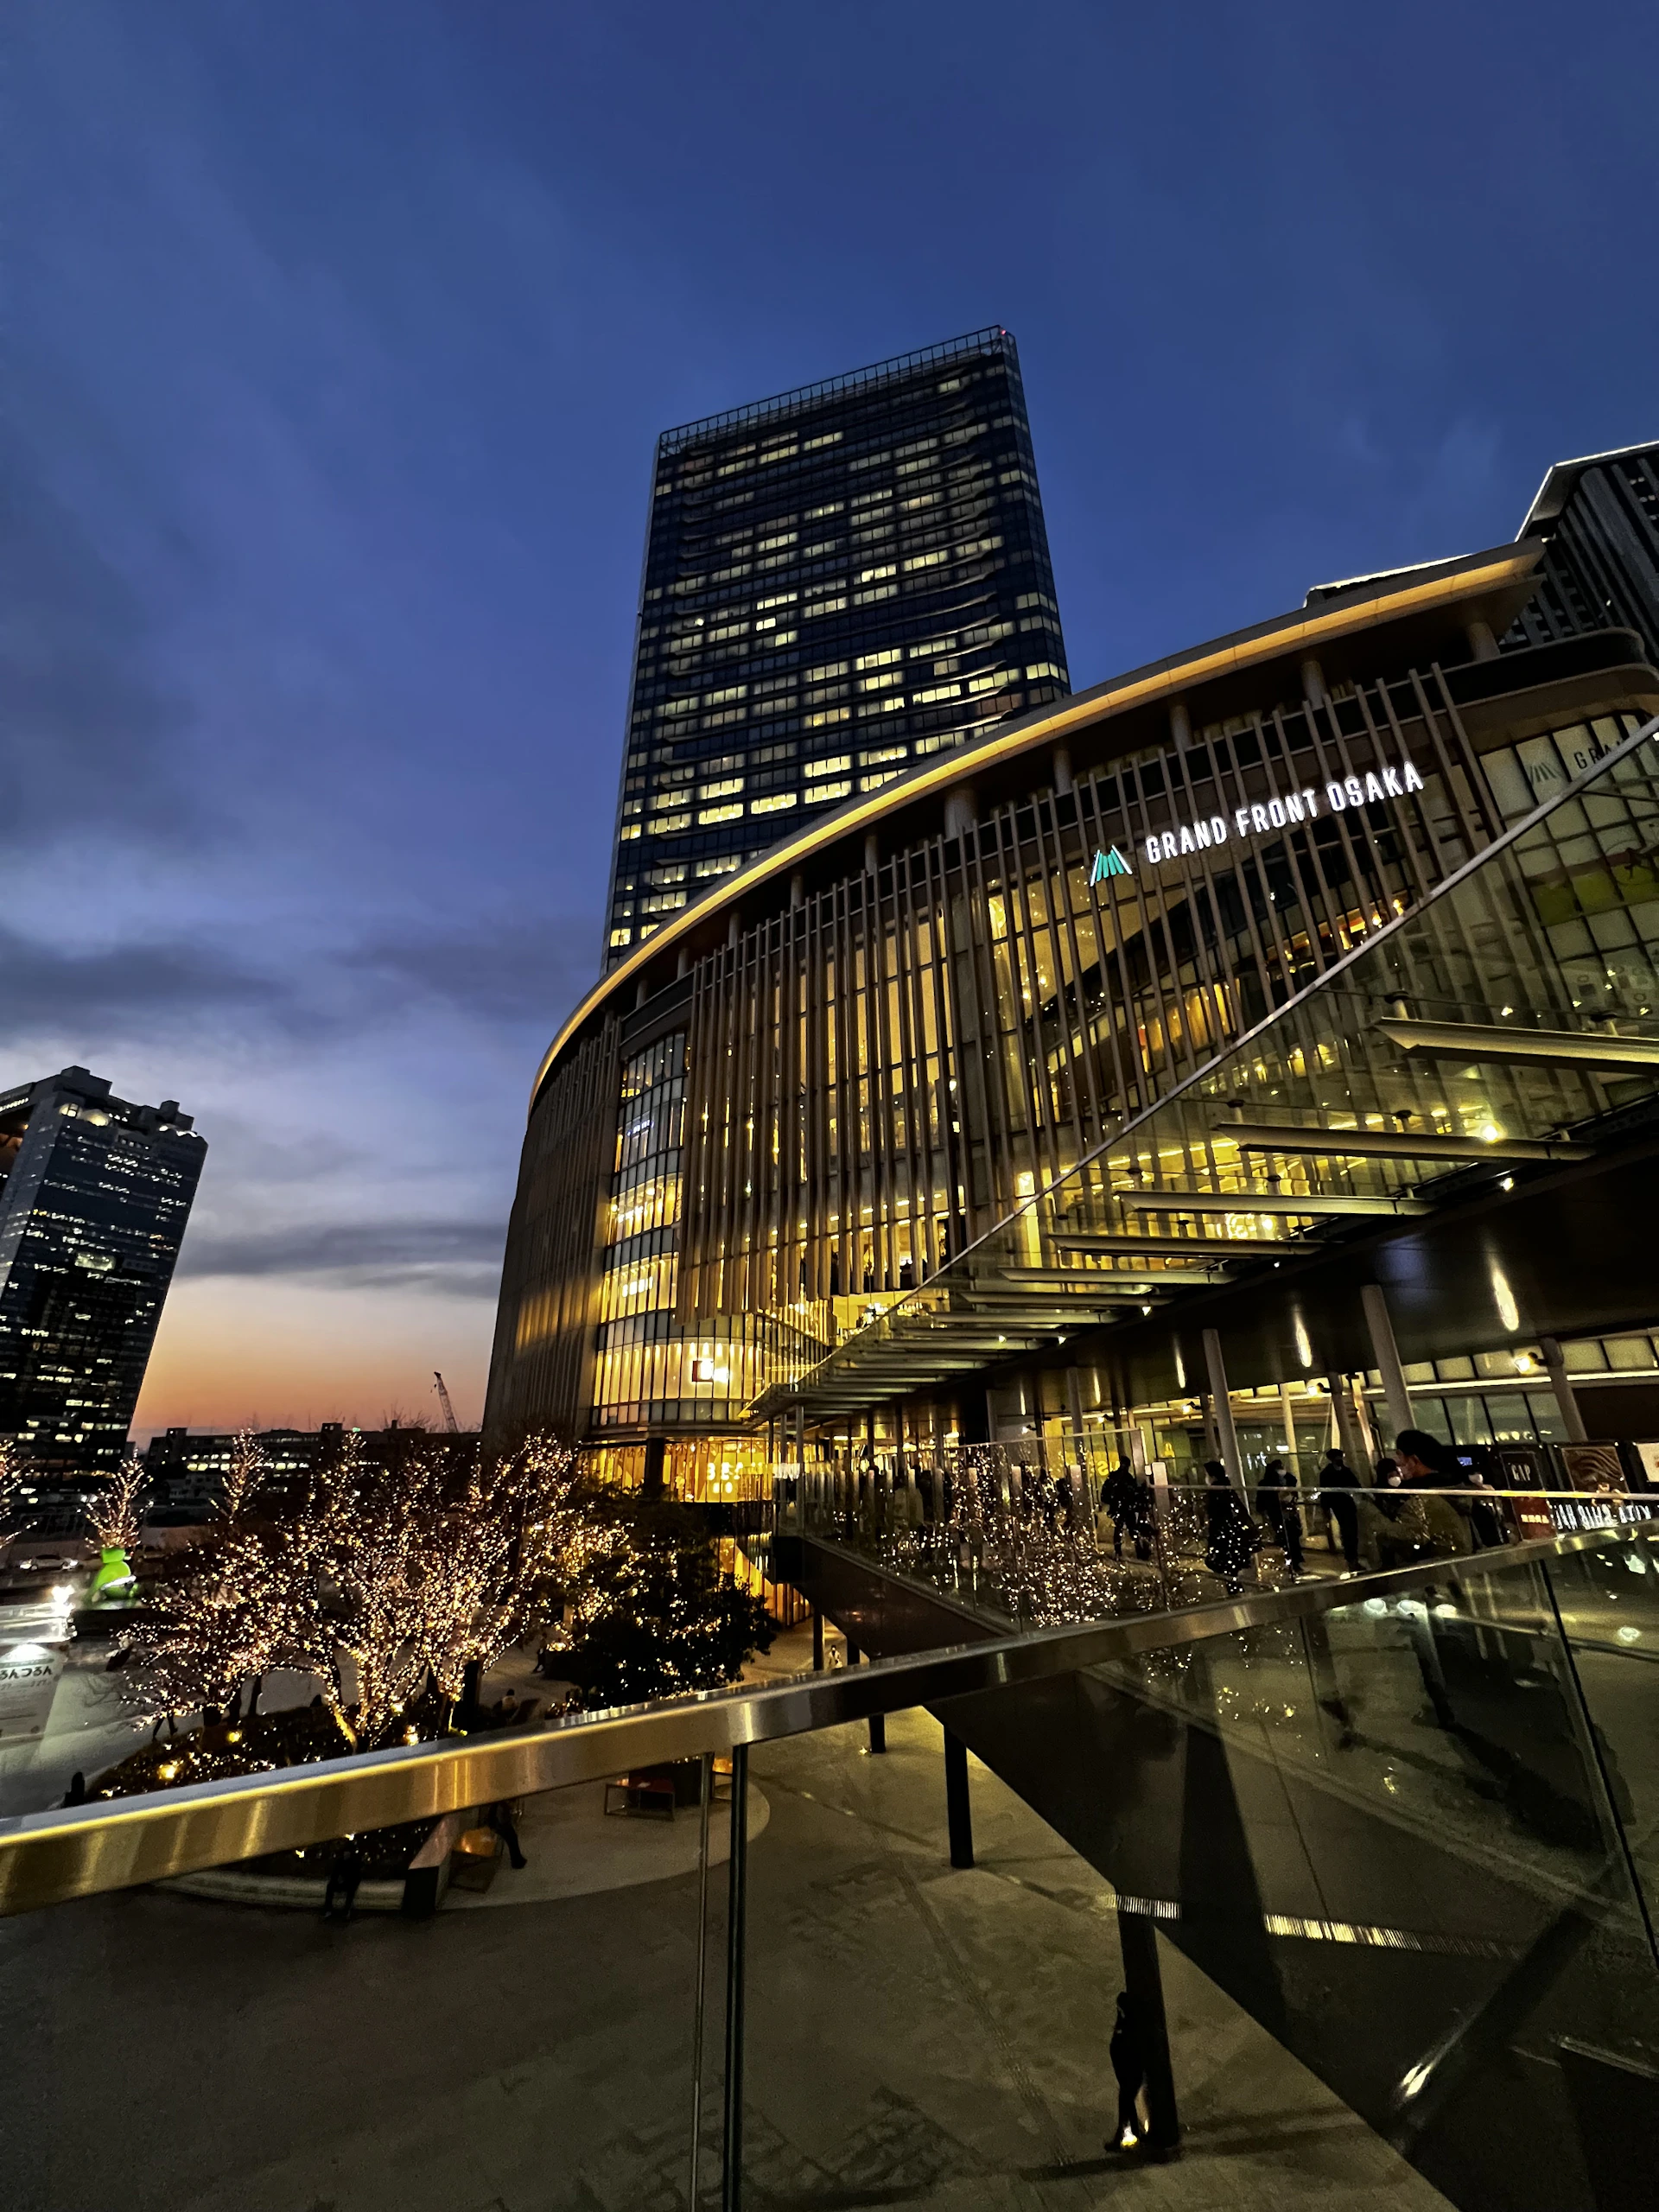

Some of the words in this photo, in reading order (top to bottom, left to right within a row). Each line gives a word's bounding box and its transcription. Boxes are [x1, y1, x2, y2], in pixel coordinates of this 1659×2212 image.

[1145, 817, 1228, 864] GRAND
[1235, 788, 1318, 837] FRONT
[1326, 761, 1424, 811] OSAKA
